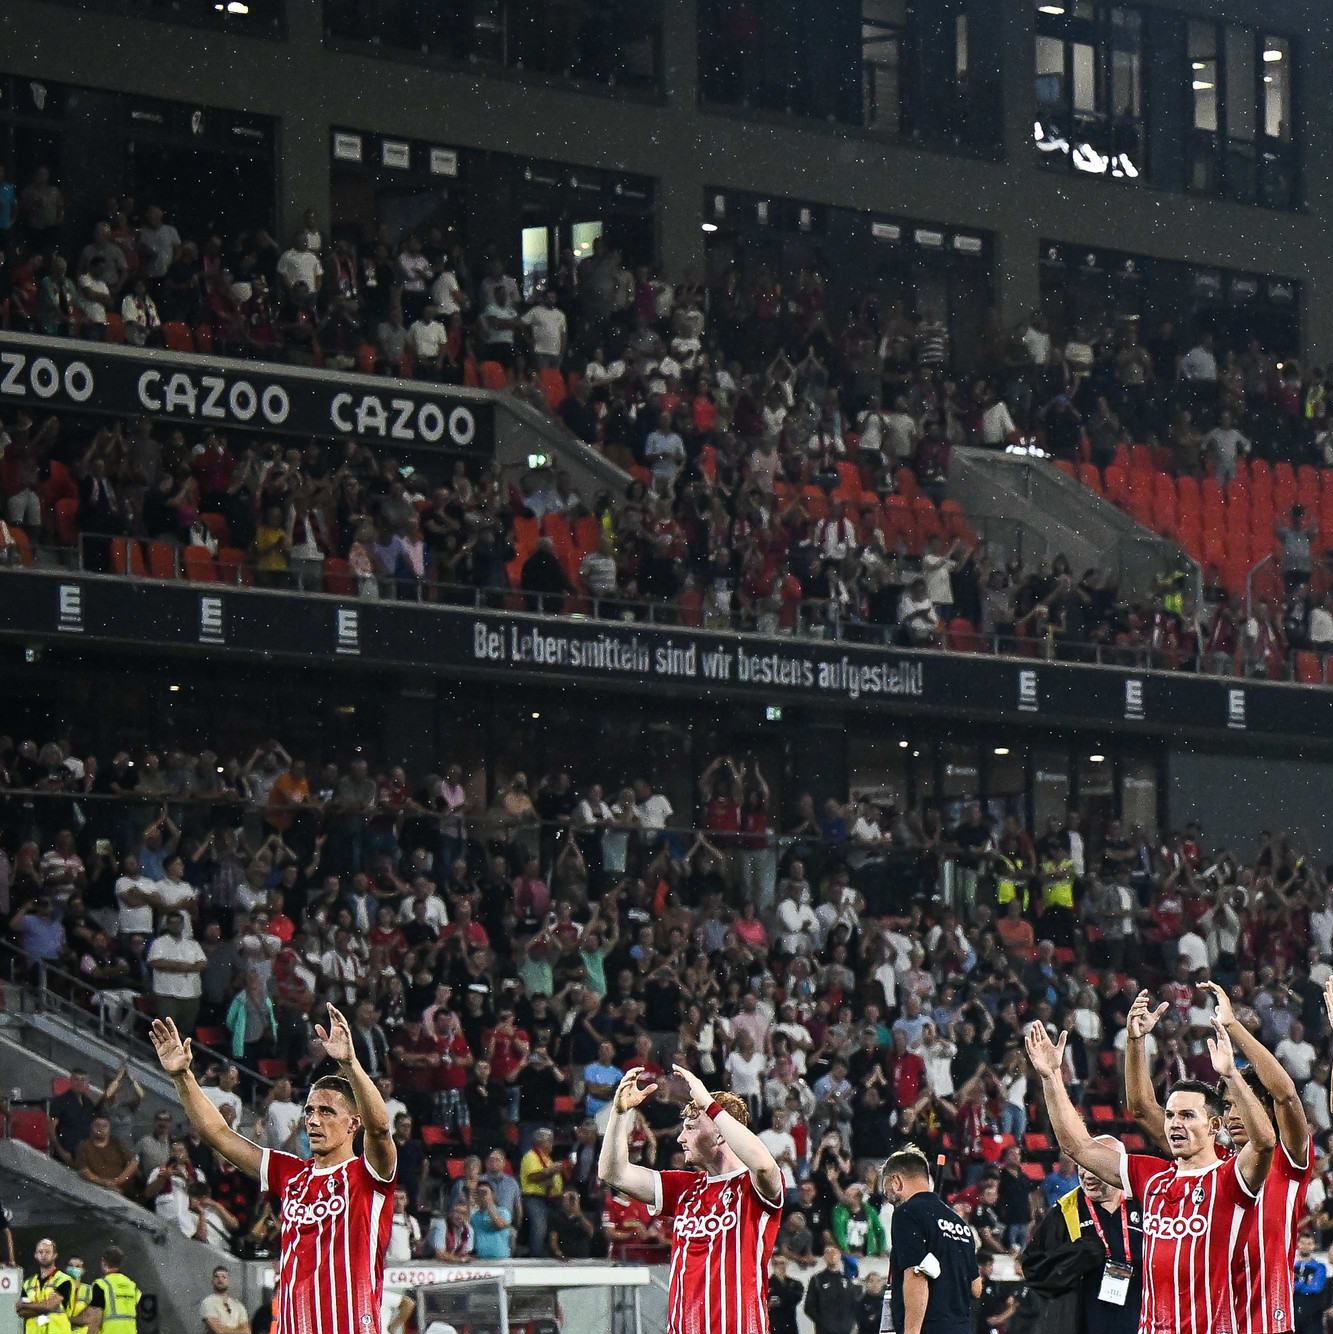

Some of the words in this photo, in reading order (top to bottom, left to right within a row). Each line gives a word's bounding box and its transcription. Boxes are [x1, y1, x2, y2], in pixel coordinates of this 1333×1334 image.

[138, 369, 290, 425] CAZOO
[330, 392, 476, 446] CAZOO
[474, 622, 505, 660] Bei
[655, 639, 696, 677] sind
[701, 644, 733, 680] wir
[738, 645, 814, 687] bestens
[818, 655, 923, 700] aufgestellt!
